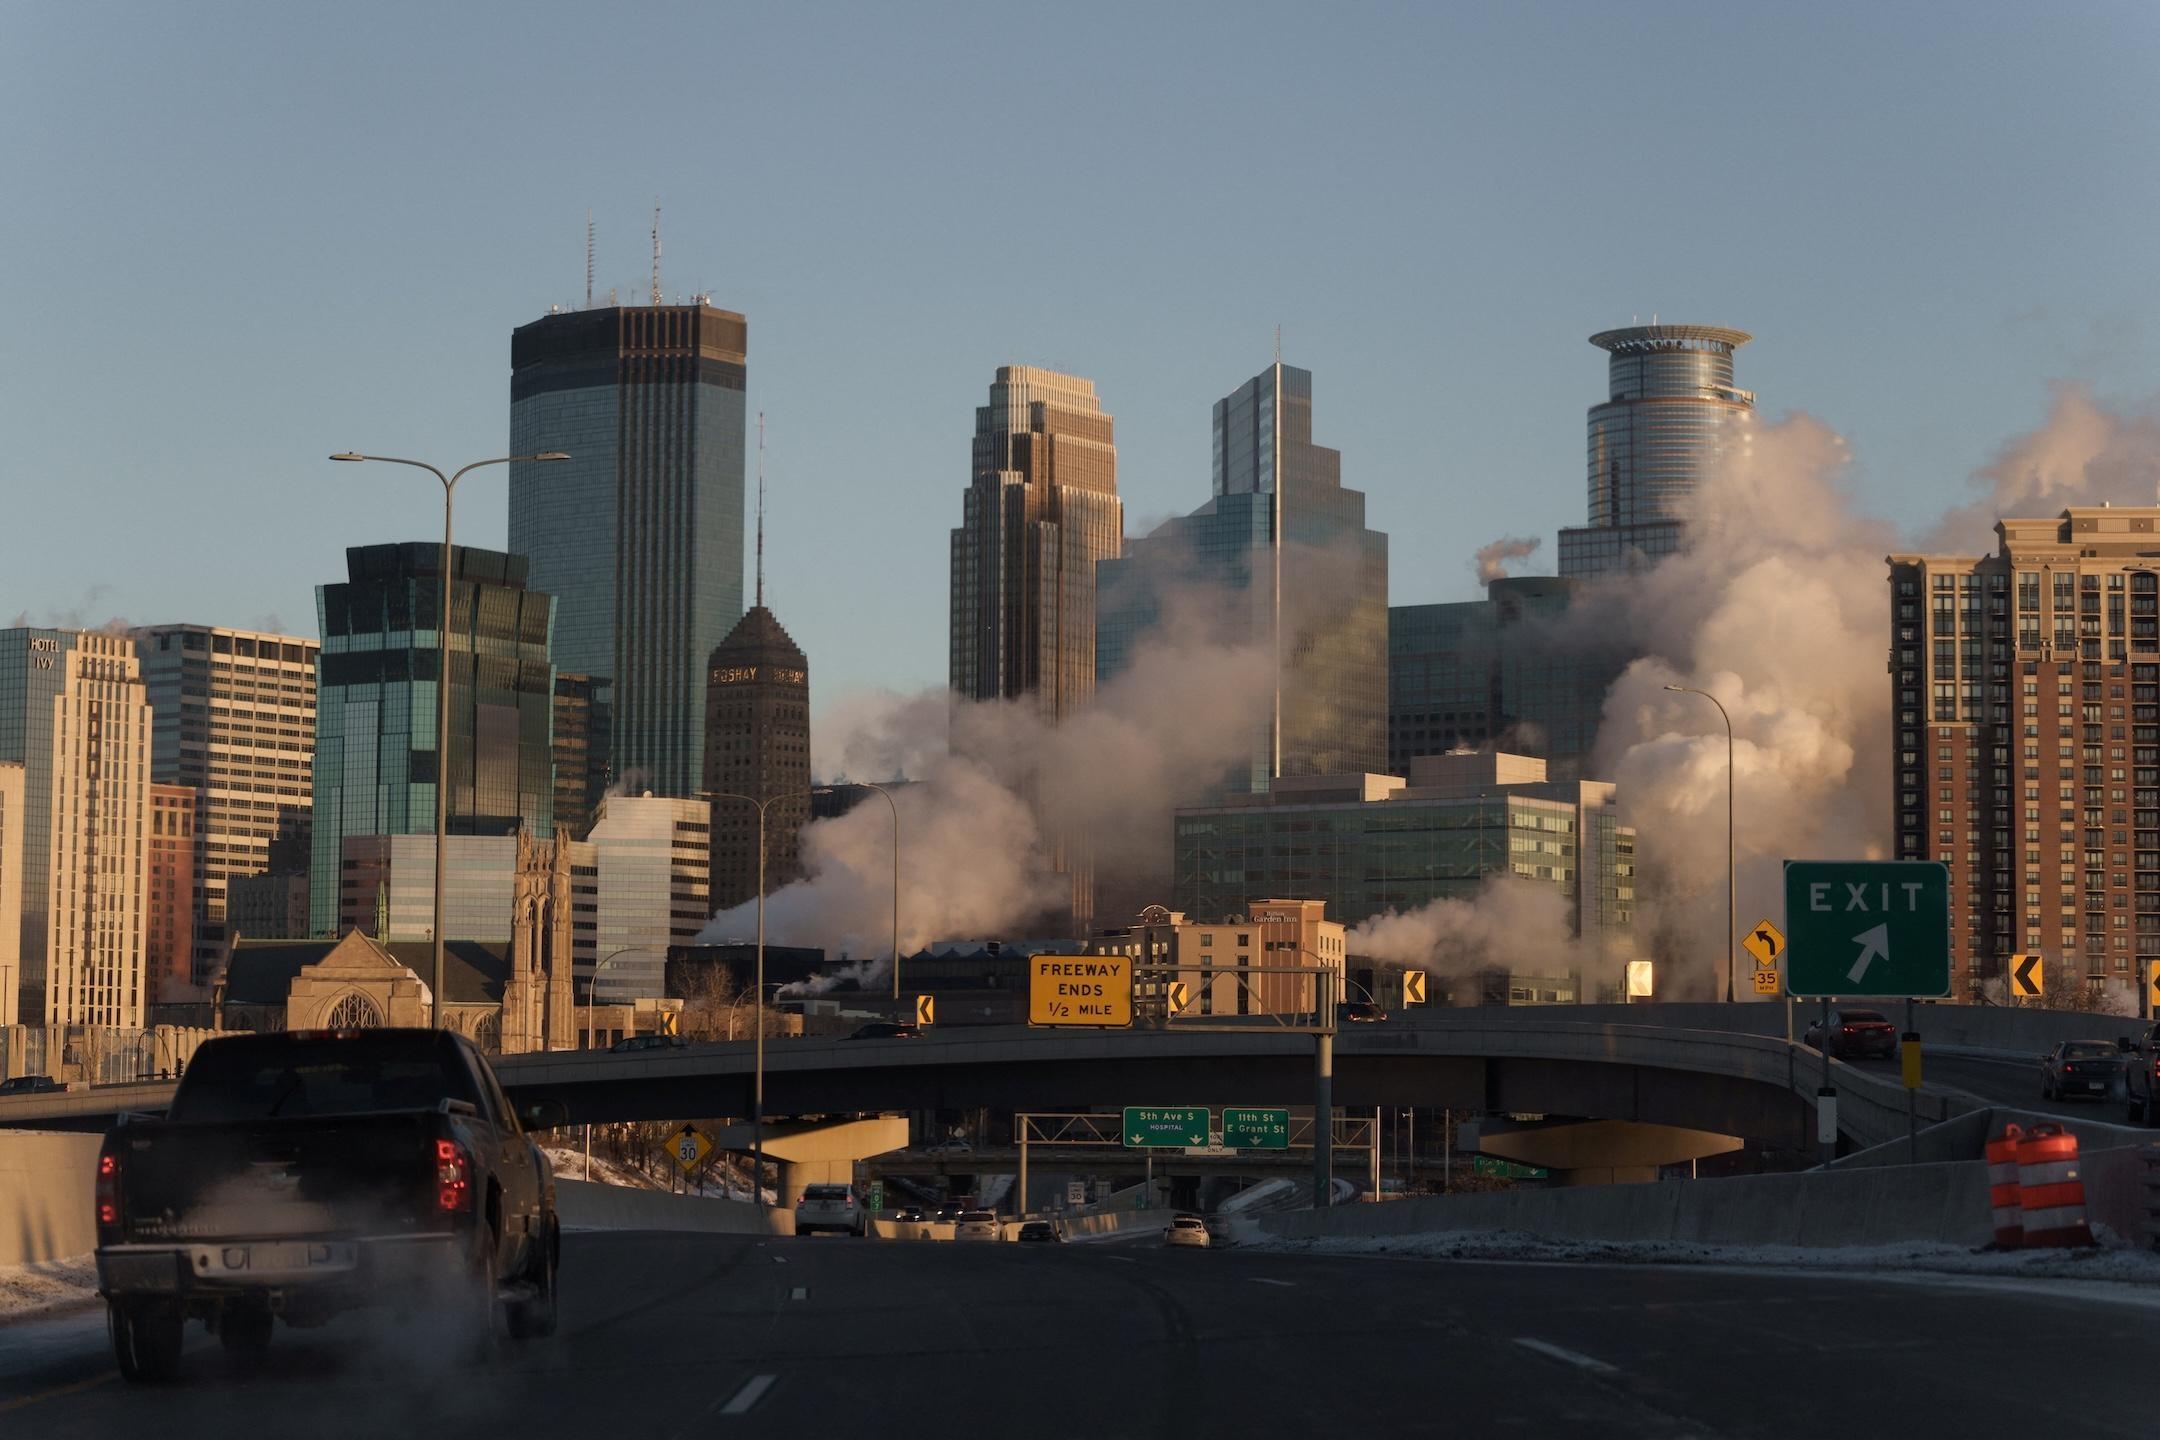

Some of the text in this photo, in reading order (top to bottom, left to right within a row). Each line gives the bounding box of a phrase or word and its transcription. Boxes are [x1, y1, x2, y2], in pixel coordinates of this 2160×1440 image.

[32, 638, 60, 653] HOTEL
[37, 656, 54, 670] IVY
[713, 667, 757, 683] FOSHAY
[1810, 882, 1923, 911] EXIT
[1253, 915, 1282, 923] Garden
[1040, 964, 1120, 977] FREEWAY
[1757, 973, 1776, 984] 35
[1058, 983, 1103, 996] ENDS
[1049, 1002, 1112, 1017] 1/2 MILE
[1140, 1112, 1194, 1121] 5th Ave S
[1238, 1113, 1275, 1122] 11th St
[1227, 1124, 1285, 1134] E Grant St
[681, 1147, 696, 1160] 30
